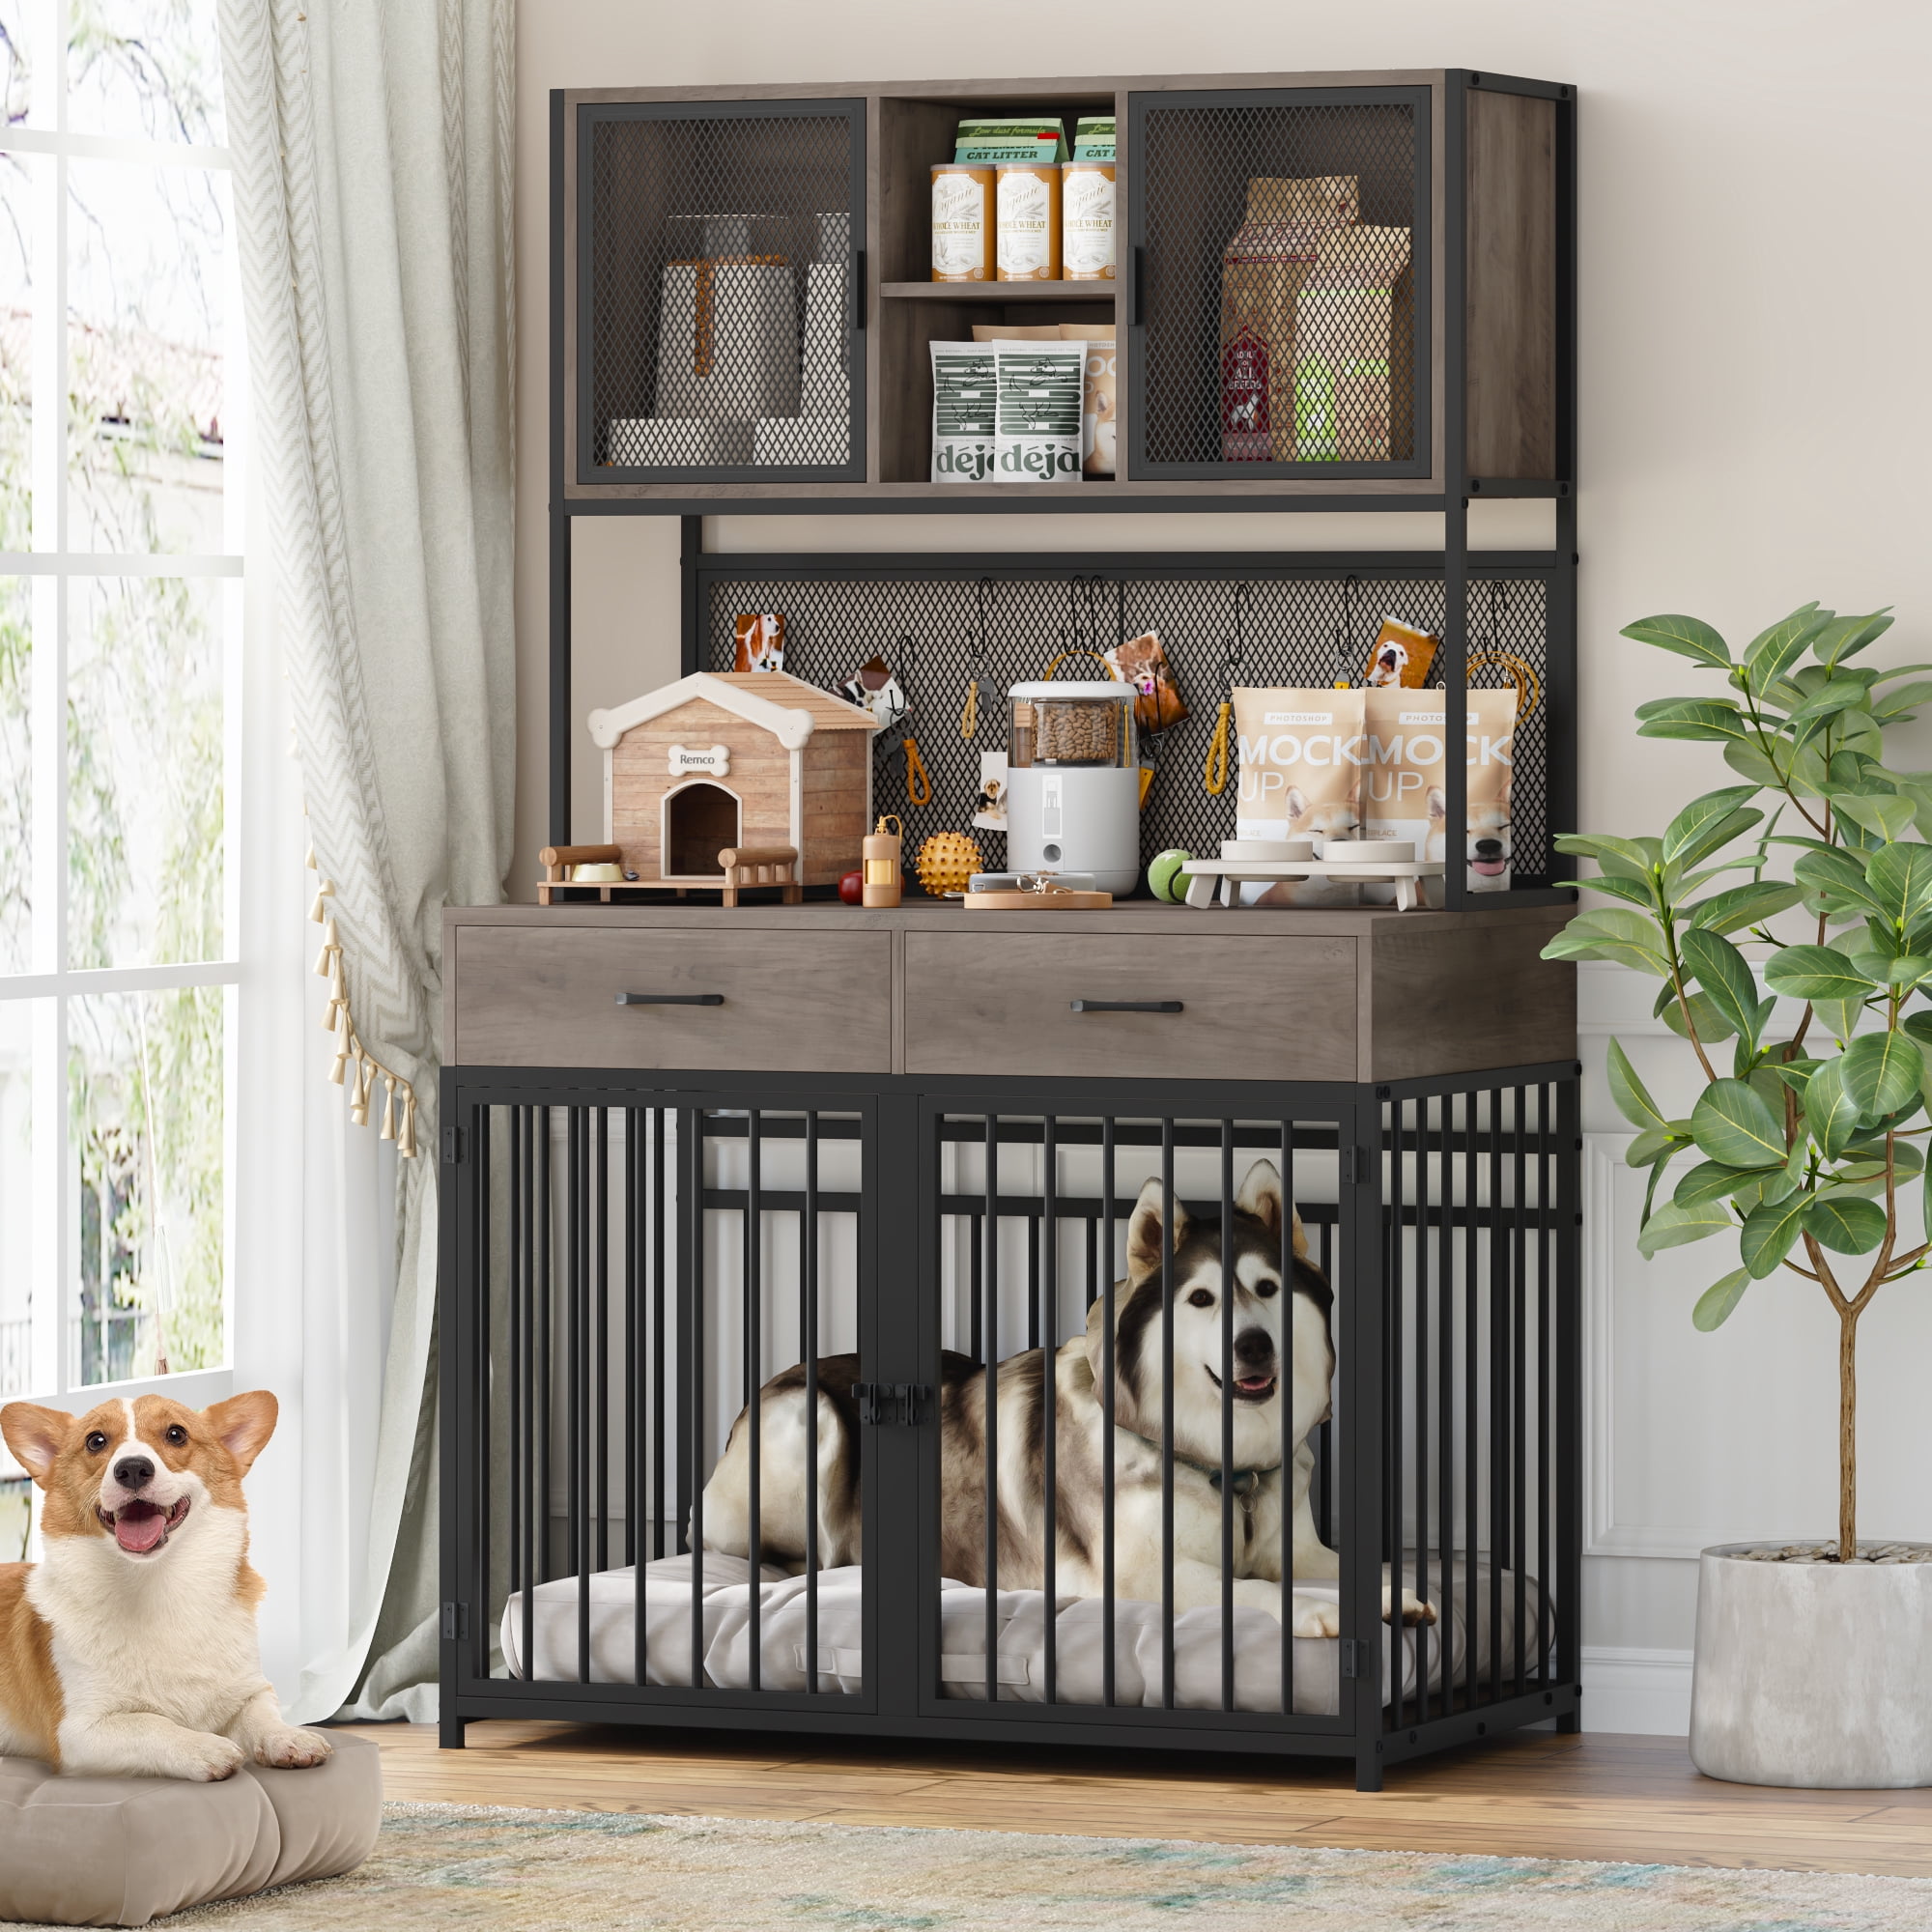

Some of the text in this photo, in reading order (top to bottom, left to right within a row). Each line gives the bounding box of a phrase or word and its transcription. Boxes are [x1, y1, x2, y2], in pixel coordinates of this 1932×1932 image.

[969, 127, 990, 137] Low
[966, 151, 1038, 160] CAT LITTER
[1086, 149, 1111, 157] CAT
[953, 221, 980, 230] WHEAT
[1018, 220, 1046, 229] WHEAT
[1085, 219, 1113, 228] WHEAT
[1237, 734, 1362, 766] MOCK
[680, 754, 715, 764] Remco
[1237, 771, 1284, 803] UP
[1368, 771, 1424, 803] UP
